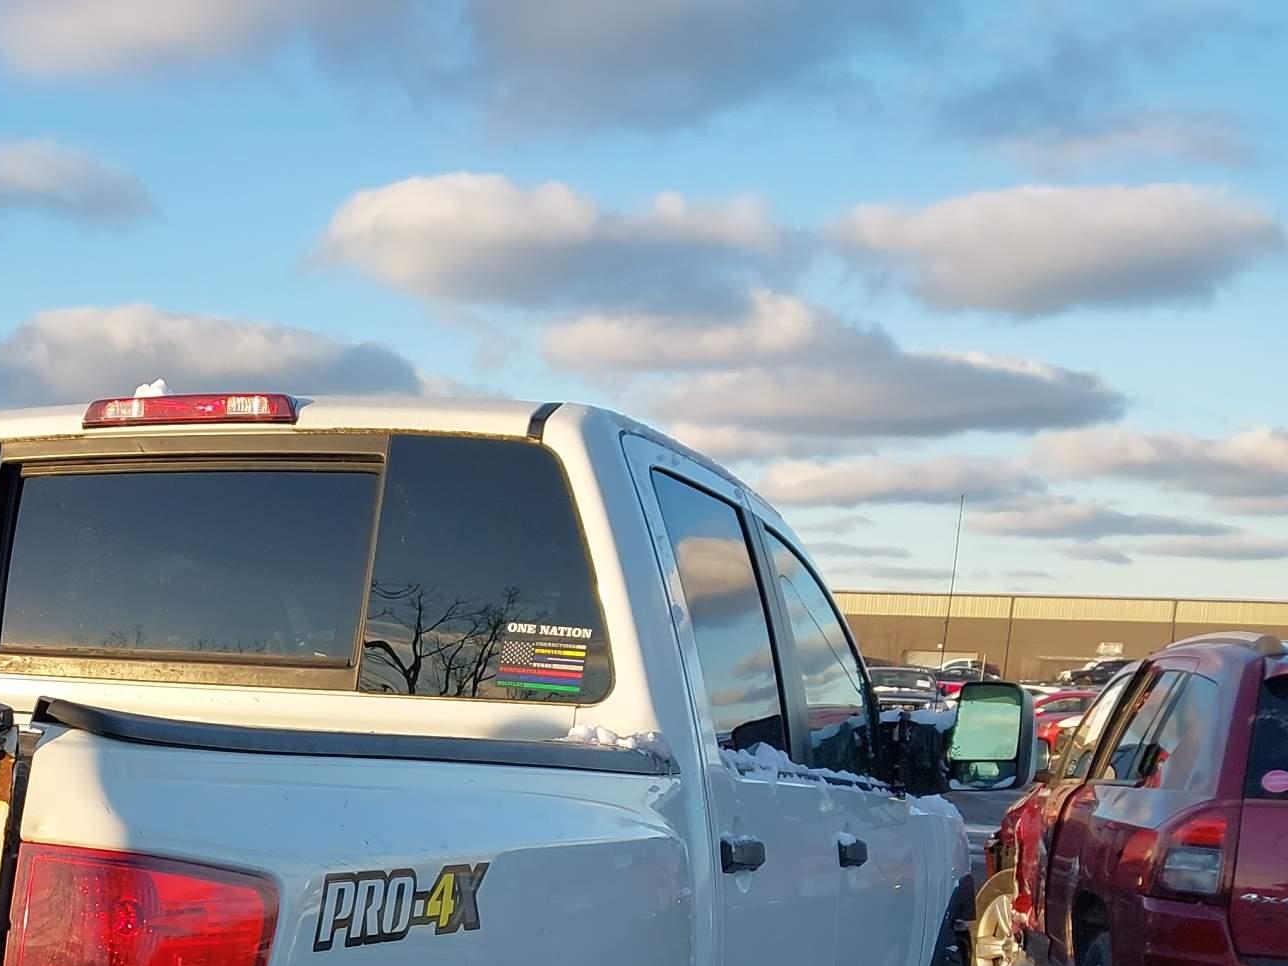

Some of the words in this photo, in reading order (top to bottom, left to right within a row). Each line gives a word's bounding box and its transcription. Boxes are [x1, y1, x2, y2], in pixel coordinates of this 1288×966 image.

[507, 622, 537, 634] ONE
[539, 625, 592, 639] NATION
[313, 862, 490, 952] PRO-4X
